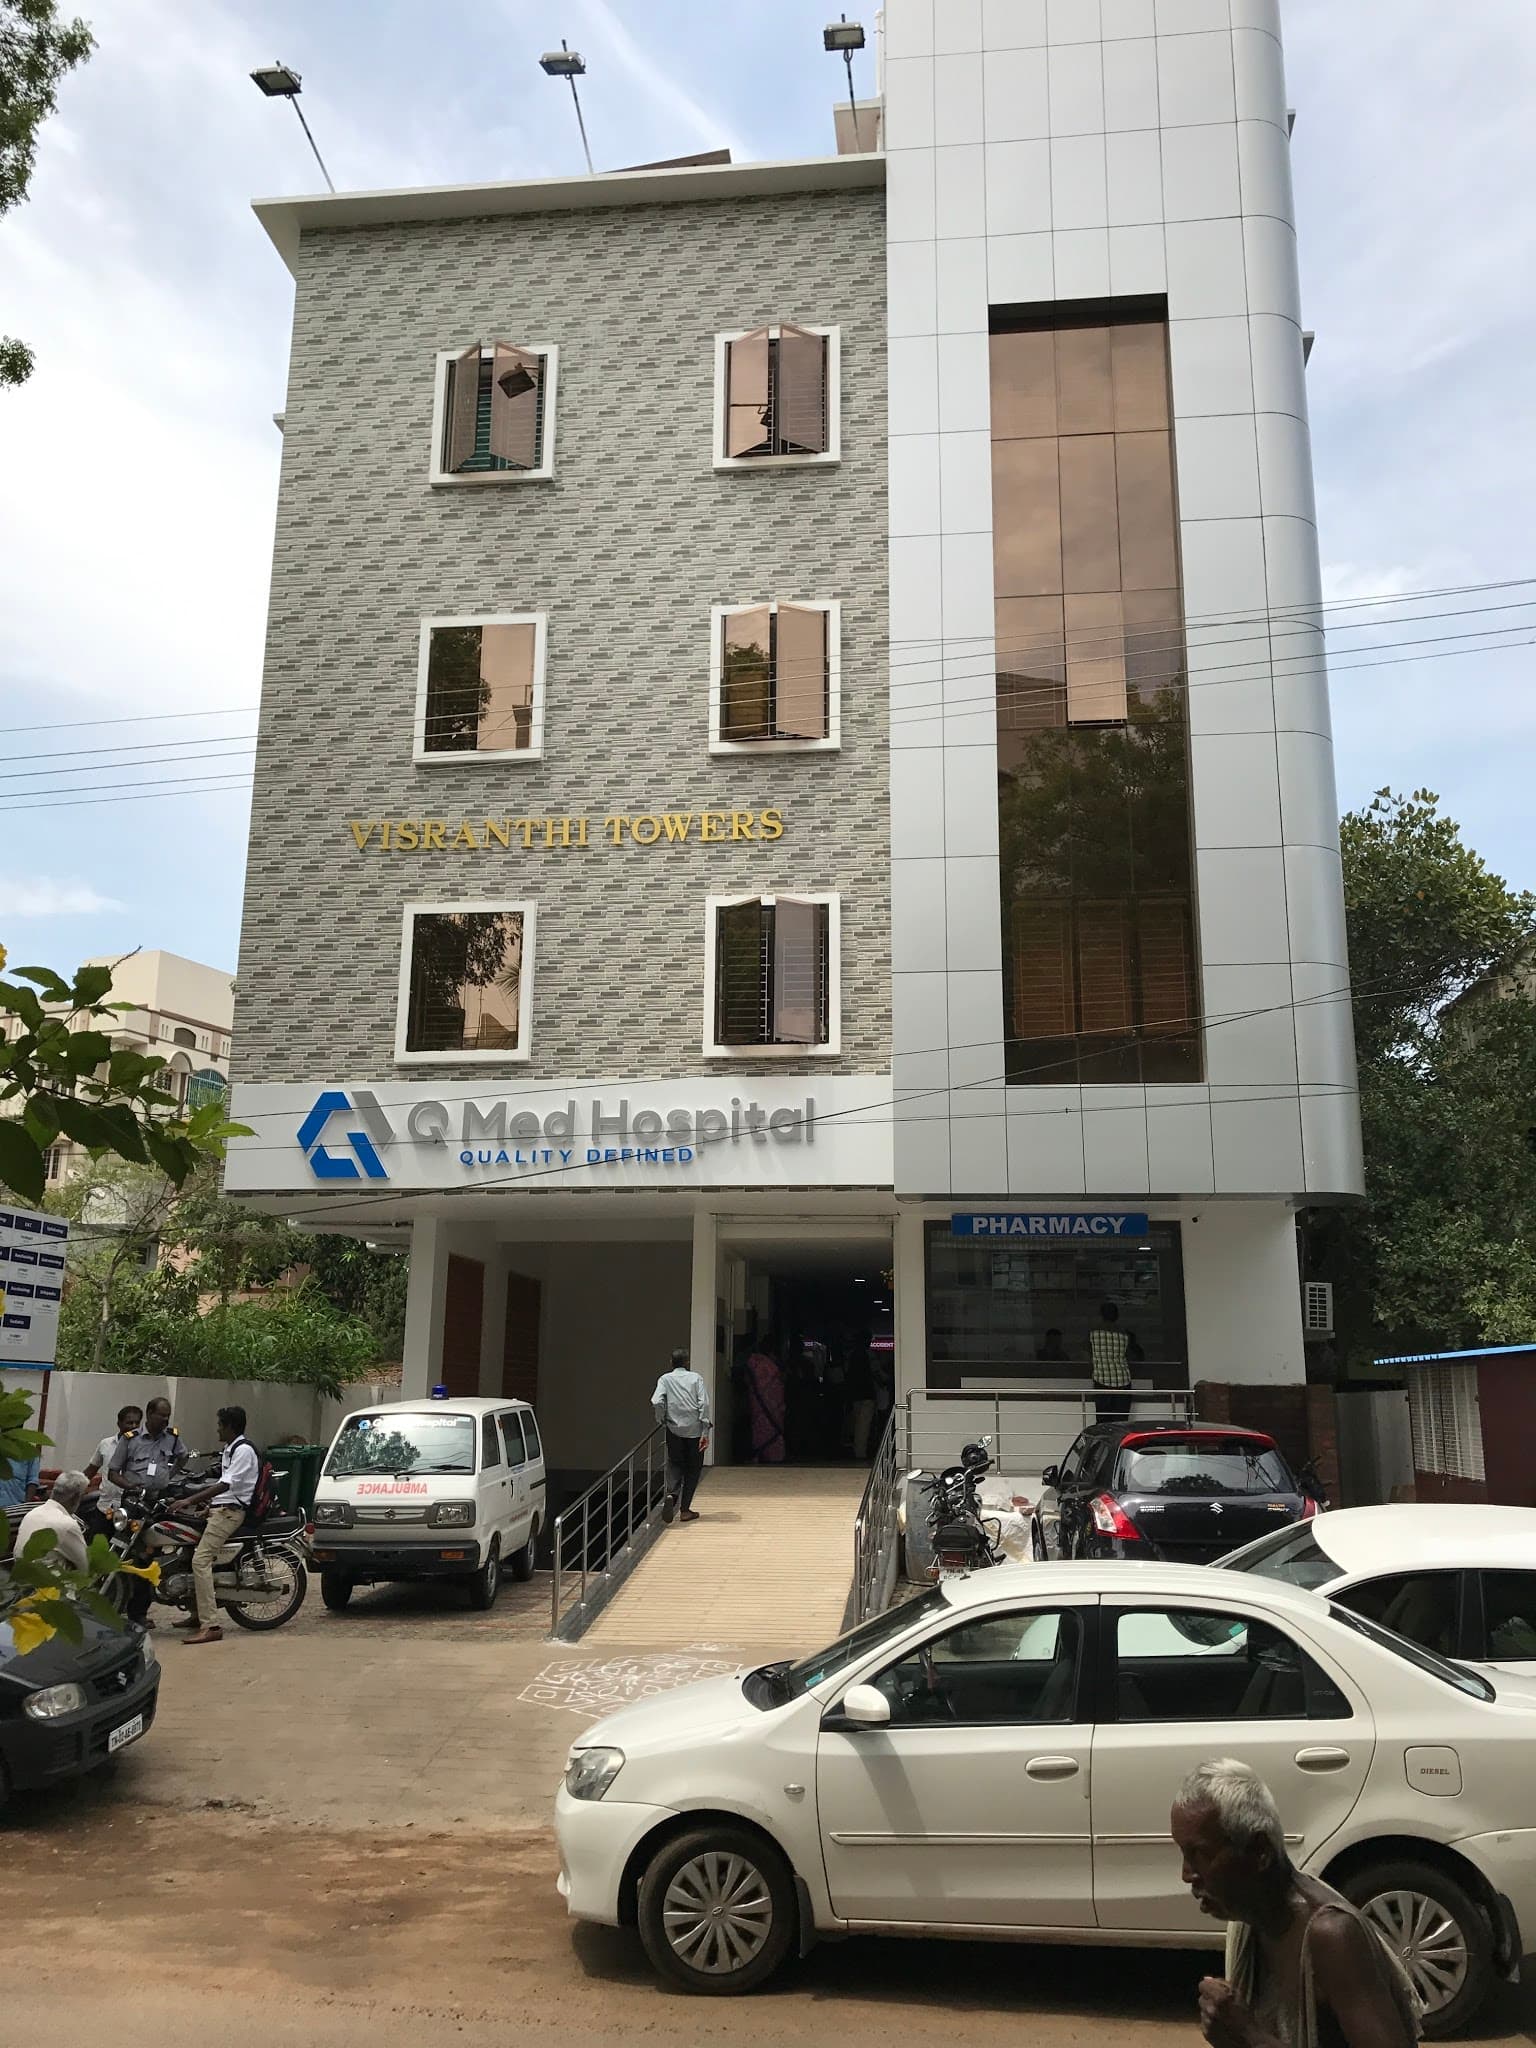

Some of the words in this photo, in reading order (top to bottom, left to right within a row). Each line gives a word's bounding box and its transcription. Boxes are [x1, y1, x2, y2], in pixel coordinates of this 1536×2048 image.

[350, 817, 590, 850] VISRANTHI
[604, 808, 784, 845] TOWERS
[407, 1100, 449, 1148] Q
[462, 1099, 576, 1144] Med
[592, 1097, 815, 1154] Hospital
[459, 1149, 574, 1166] QUALITY
[587, 1147, 693, 1163] DEFINED
[972, 1216, 1127, 1235] PHARMACY
[1420, 1767, 1450, 1775] DIESEL
